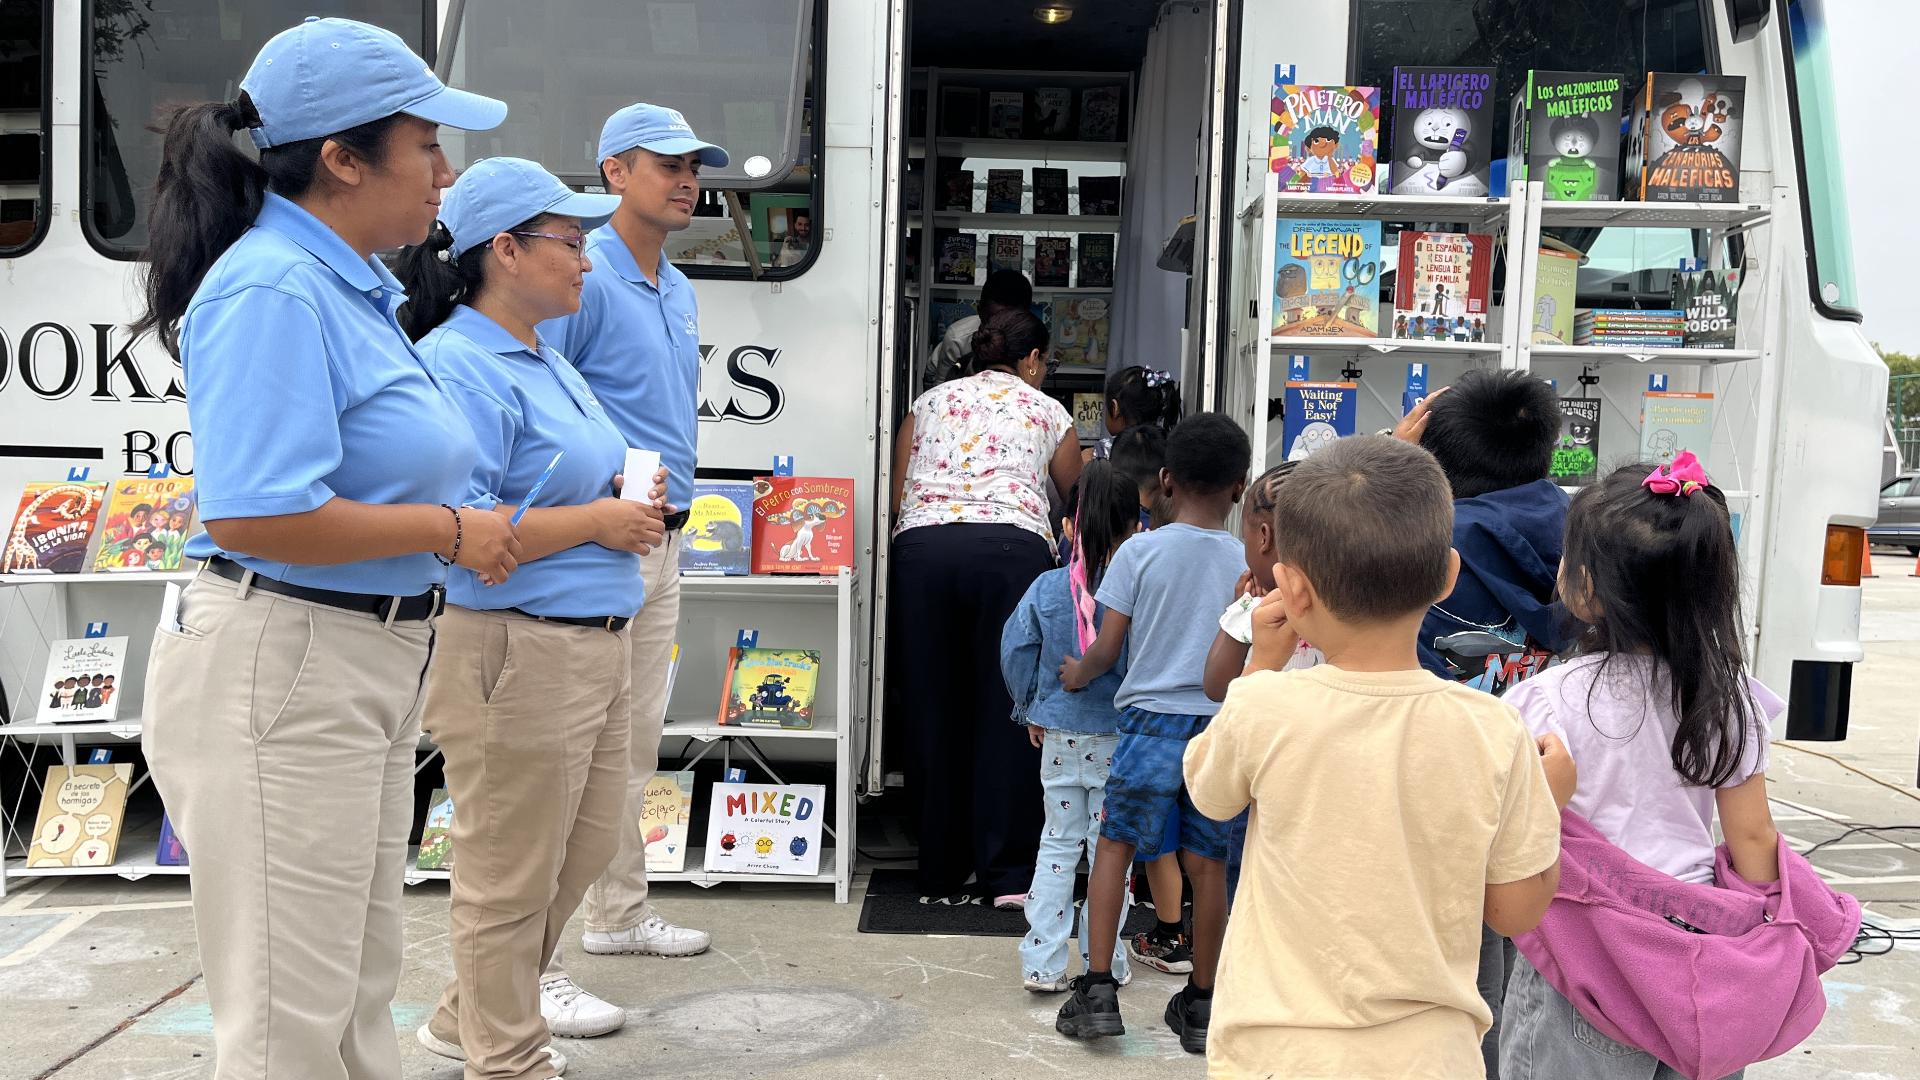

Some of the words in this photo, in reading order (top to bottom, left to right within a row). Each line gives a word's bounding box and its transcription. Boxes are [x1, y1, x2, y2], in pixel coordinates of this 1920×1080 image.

[1400, 74, 1415, 90] EL
[1420, 74, 1490, 90] LAPICERO
[1537, 85, 1554, 99] LOS
[1557, 79, 1619, 97] CALZONCILLOS
[1283, 90, 1364, 128] PALETERO
[1547, 95, 1613, 118] MALÉFICOS
[1304, 105, 1358, 135] MAN
[1662, 152, 1724, 168] ZANAHORIAS
[1291, 233, 1364, 260] LEGEND
[1427, 244, 1434, 252] EL
[1436, 244, 1464, 253] ESPAÑOL
[1445, 255, 1453, 263] LA
[1427, 264, 1451, 273] LENGUA
[1453, 266, 1462, 274] DE
[1428, 275, 1433, 283] MI
[1436, 275, 1459, 284] FAMILIA
[1693, 295, 1722, 306] THE
[1686, 306, 1728, 319] WILD
[0, 322, 189, 403] OK
[1300, 389, 1343, 402] Waiting
[1304, 400, 1315, 410] Is
[1318, 400, 1337, 410] Not
[1305, 410, 1337, 422] Easy!
[755, 506, 766, 516] El
[762, 490, 790, 511] Perro
[791, 486, 804, 496] con
[803, 482, 849, 498] Sombrero
[51, 538, 62, 547] LA
[74, 783, 101, 793] secreto
[643, 787, 672, 797] ueño
[62, 797, 98, 808] hormigas
[727, 792, 814, 821] MIXED
[775, 818, 791, 826] Story
